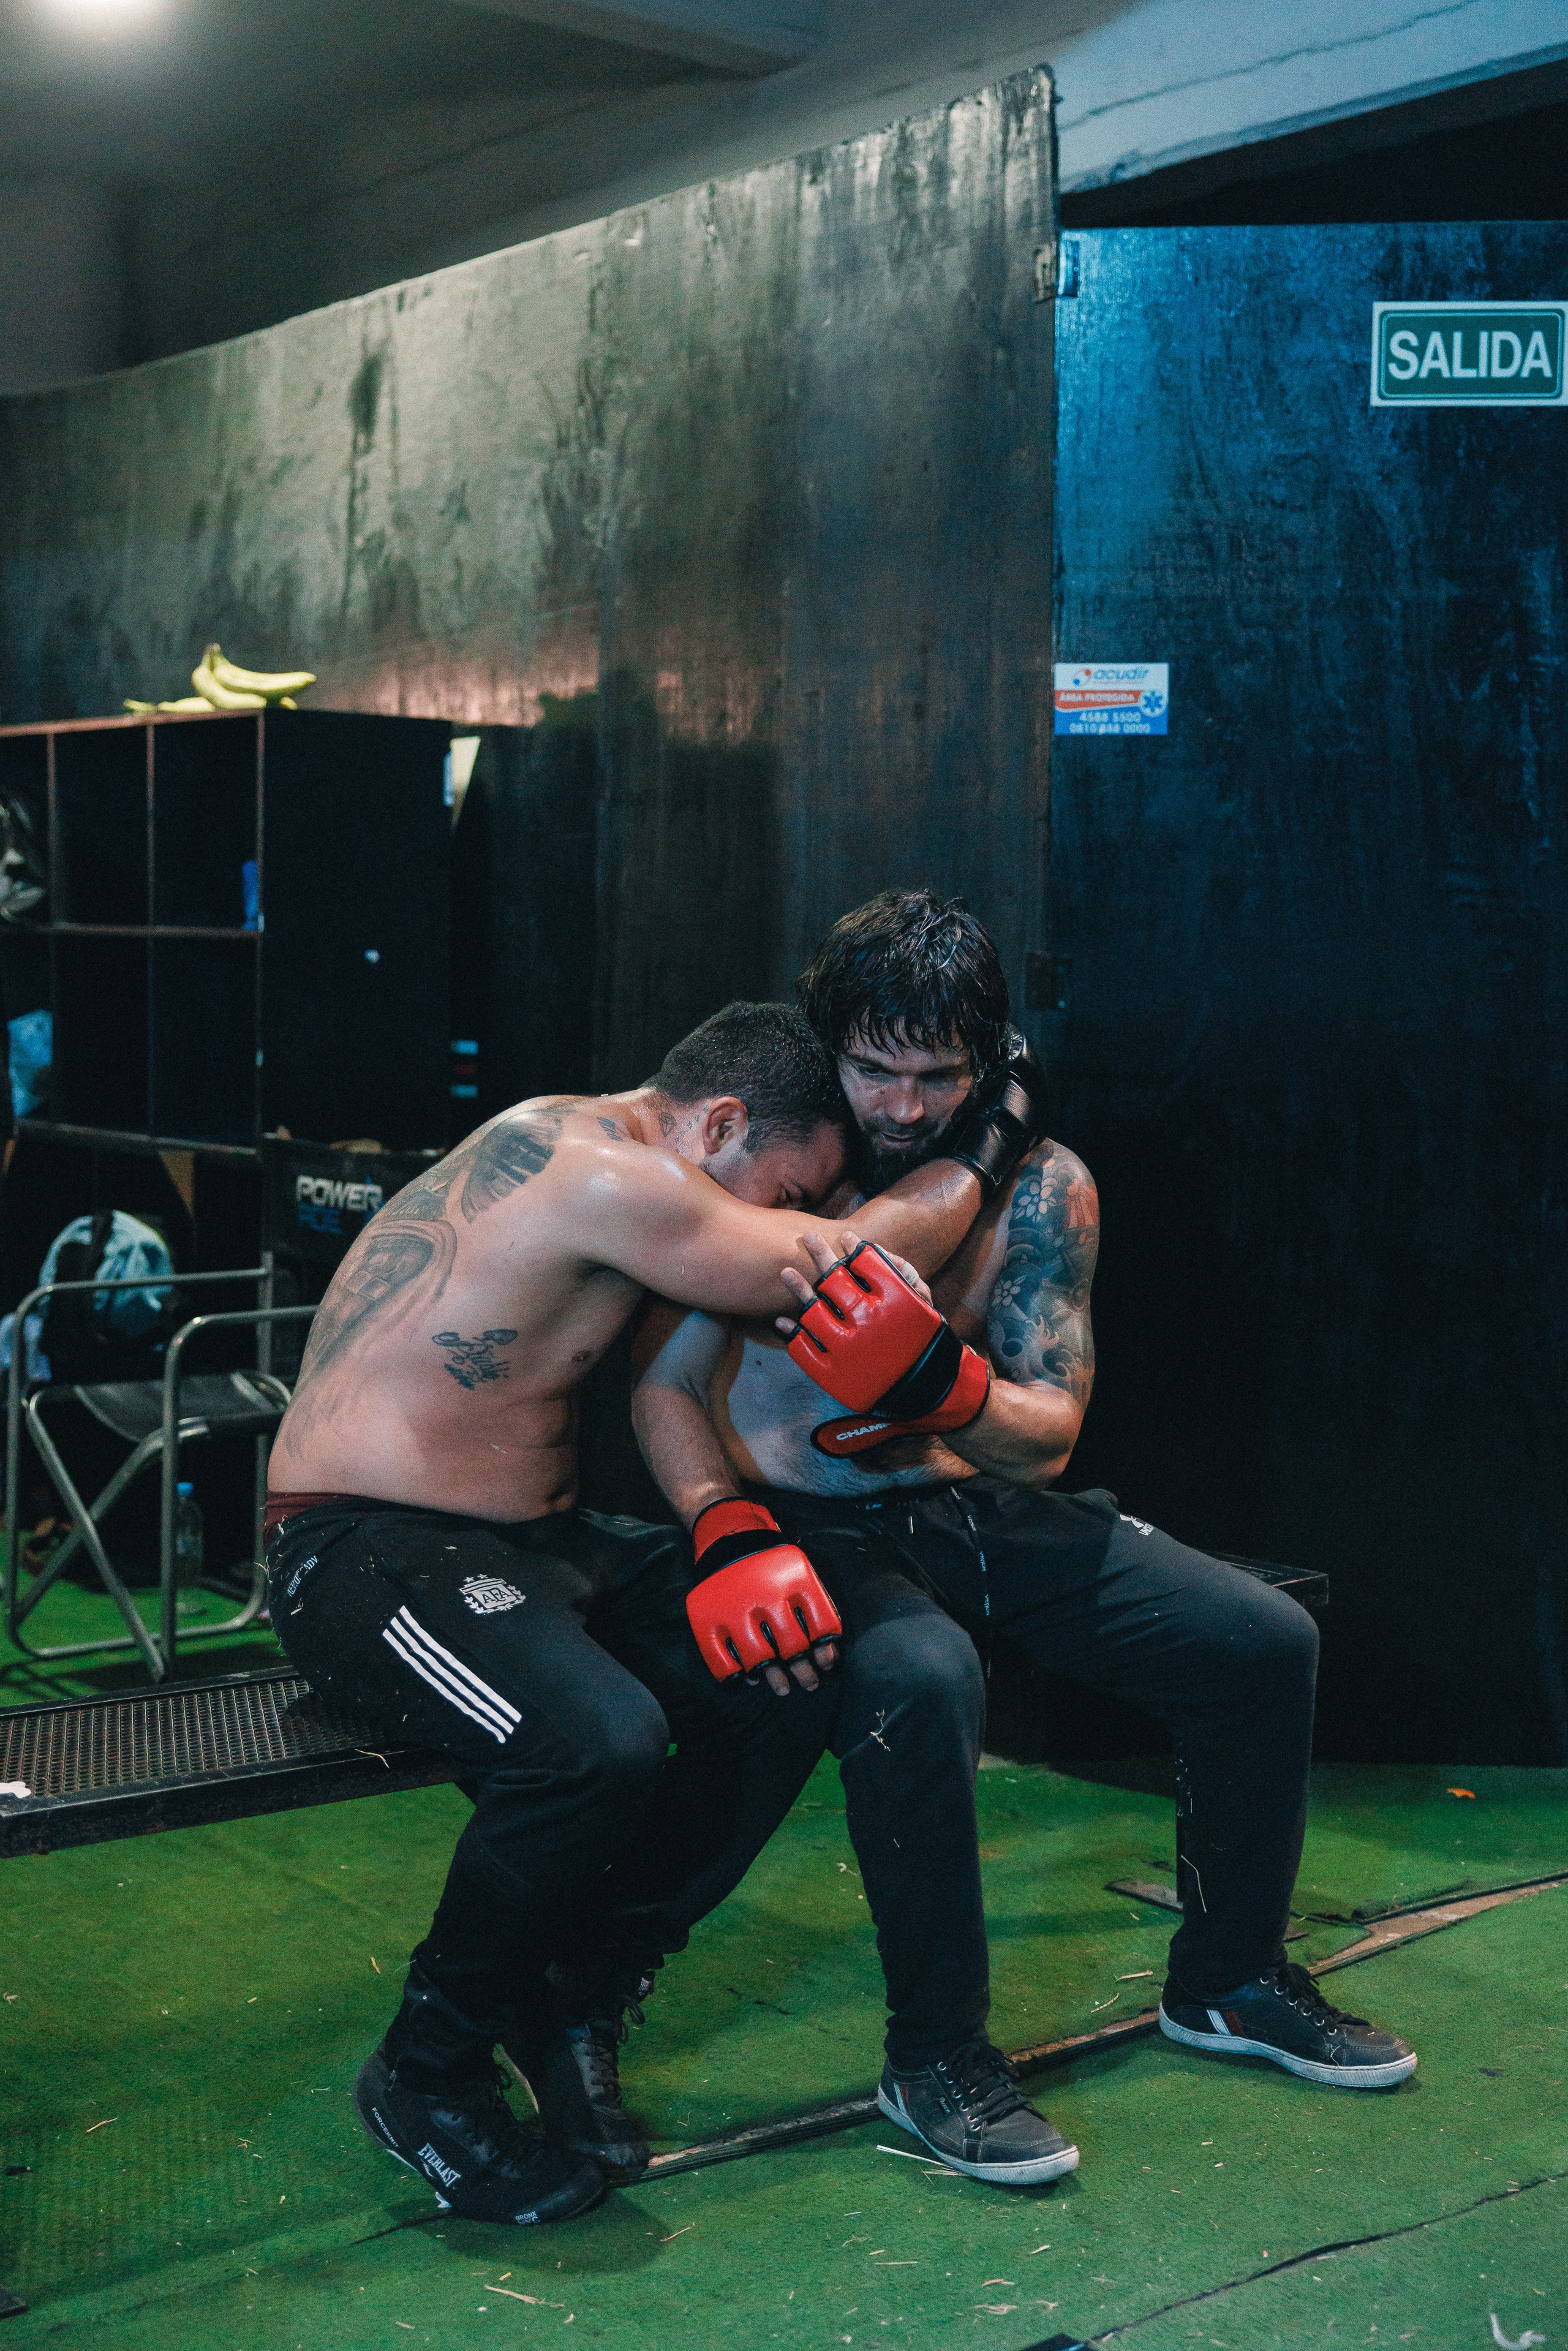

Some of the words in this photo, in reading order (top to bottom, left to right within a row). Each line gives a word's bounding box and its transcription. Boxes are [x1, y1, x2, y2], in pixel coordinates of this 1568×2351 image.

[1388, 330, 1553, 380] SALIDA
[1093, 667, 1150, 680] acudir
[296, 1174, 383, 1212] POWER
[480, 1588, 513, 1604] AFA
[372, 2107, 399, 2148] FORCEKNIT
[417, 2143, 461, 2187] EVERLAST
[515, 2211, 537, 2221] BRONX
